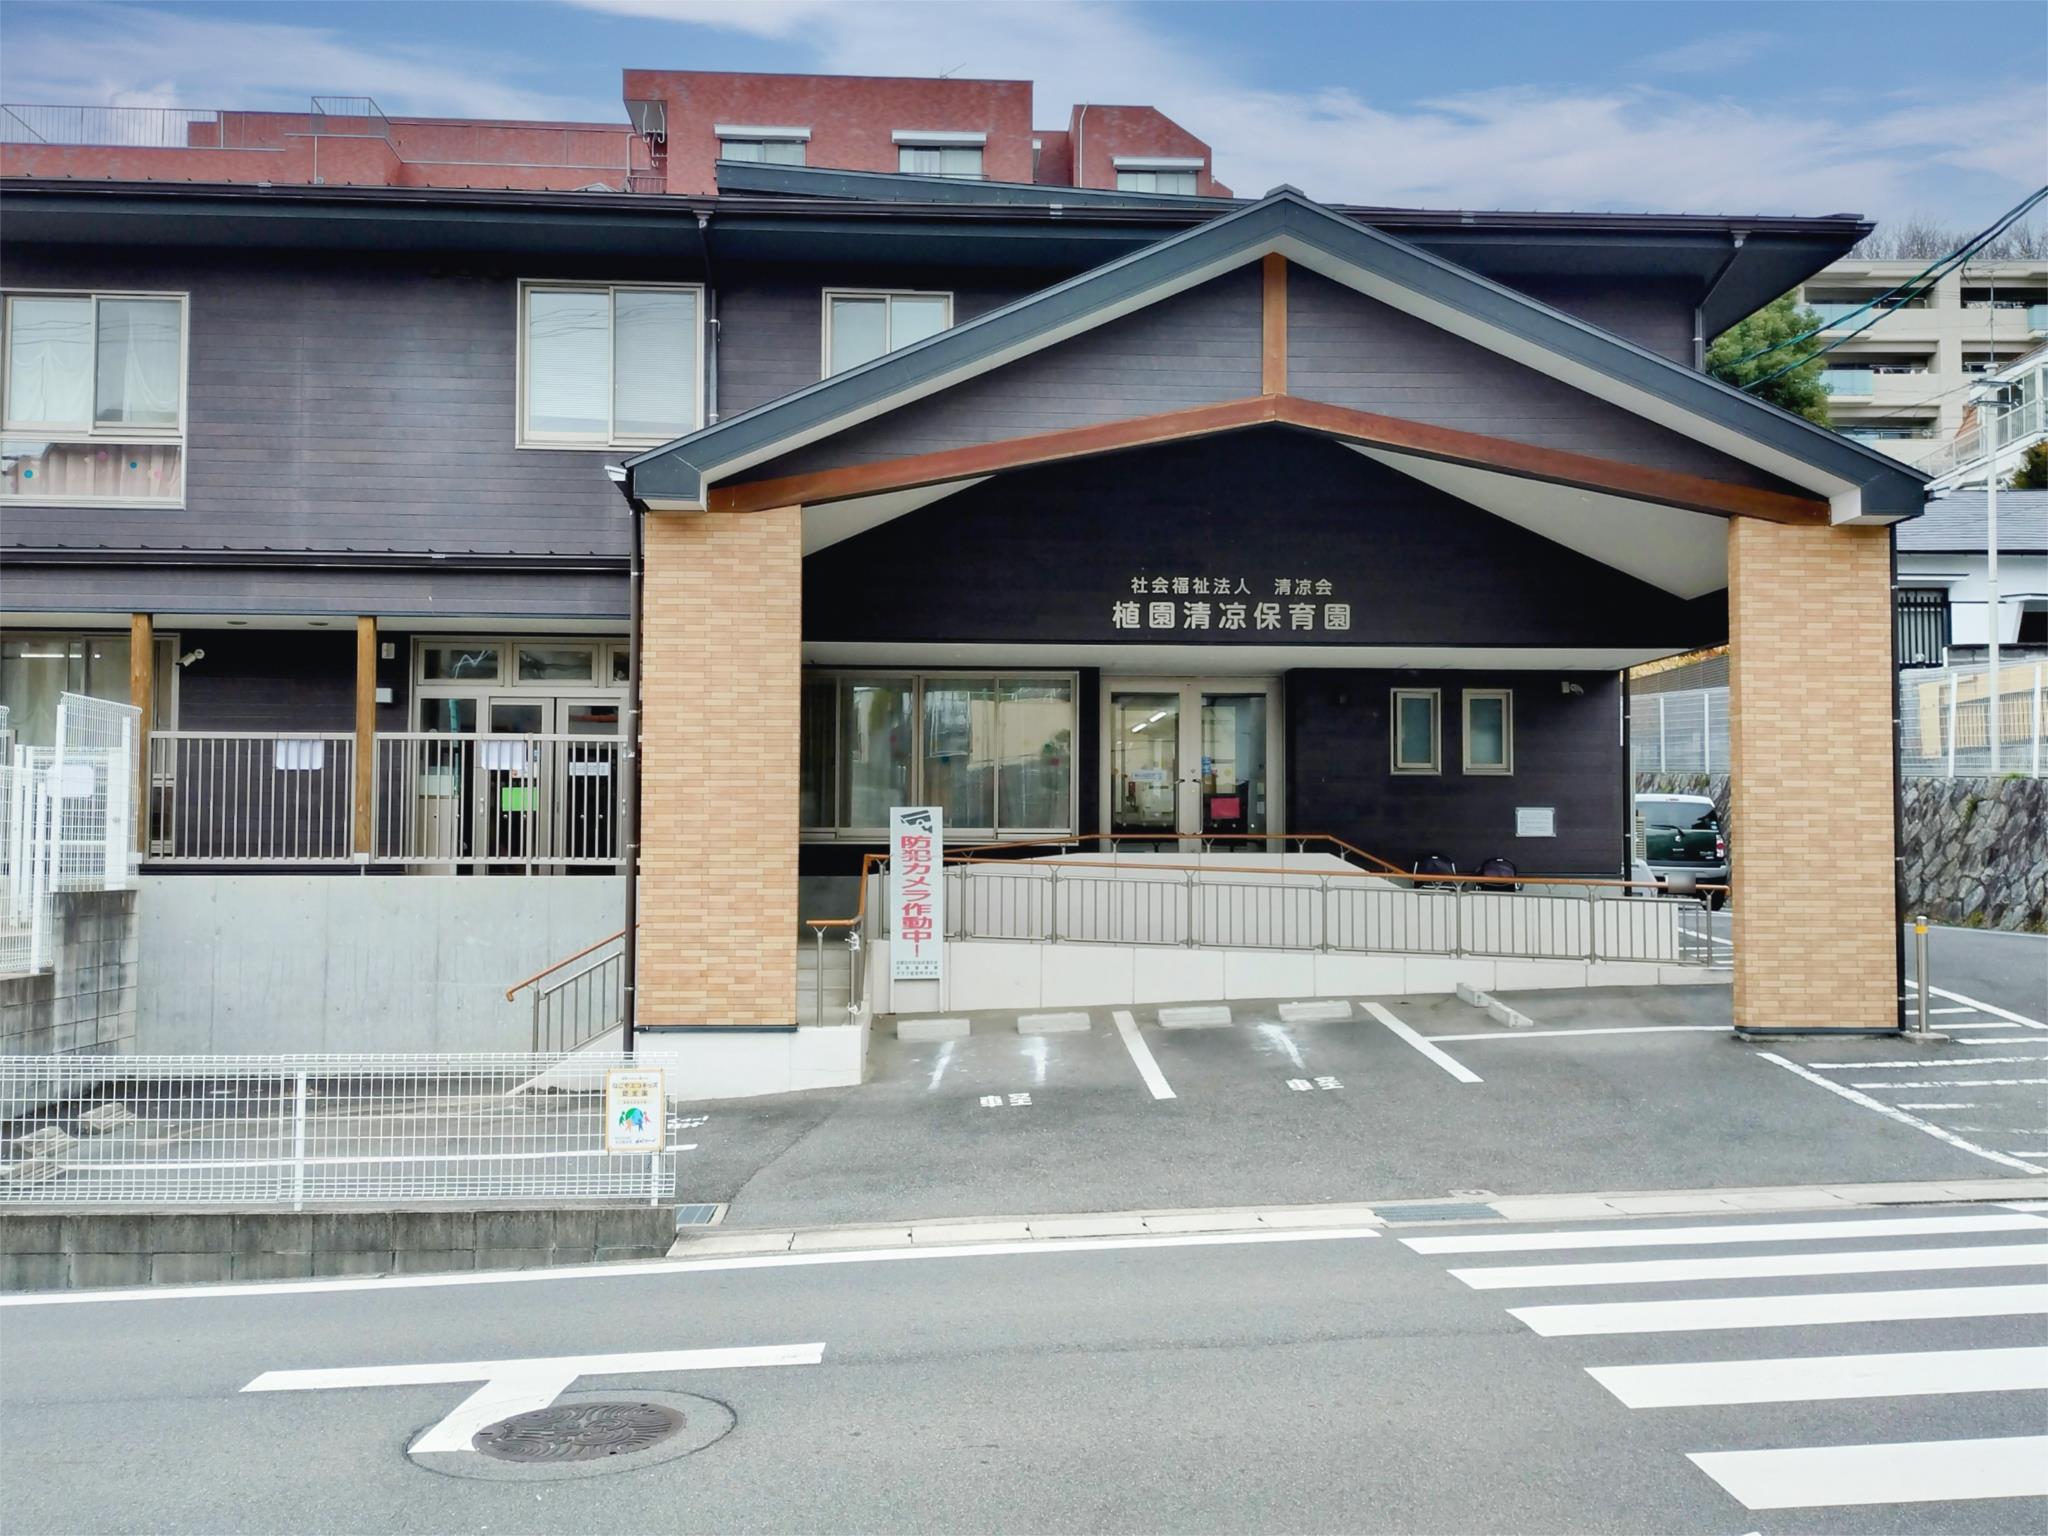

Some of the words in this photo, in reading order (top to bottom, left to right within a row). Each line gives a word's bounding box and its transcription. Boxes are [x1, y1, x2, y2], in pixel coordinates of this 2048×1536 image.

[1130, 576, 1252, 595] 社会福祉法人
